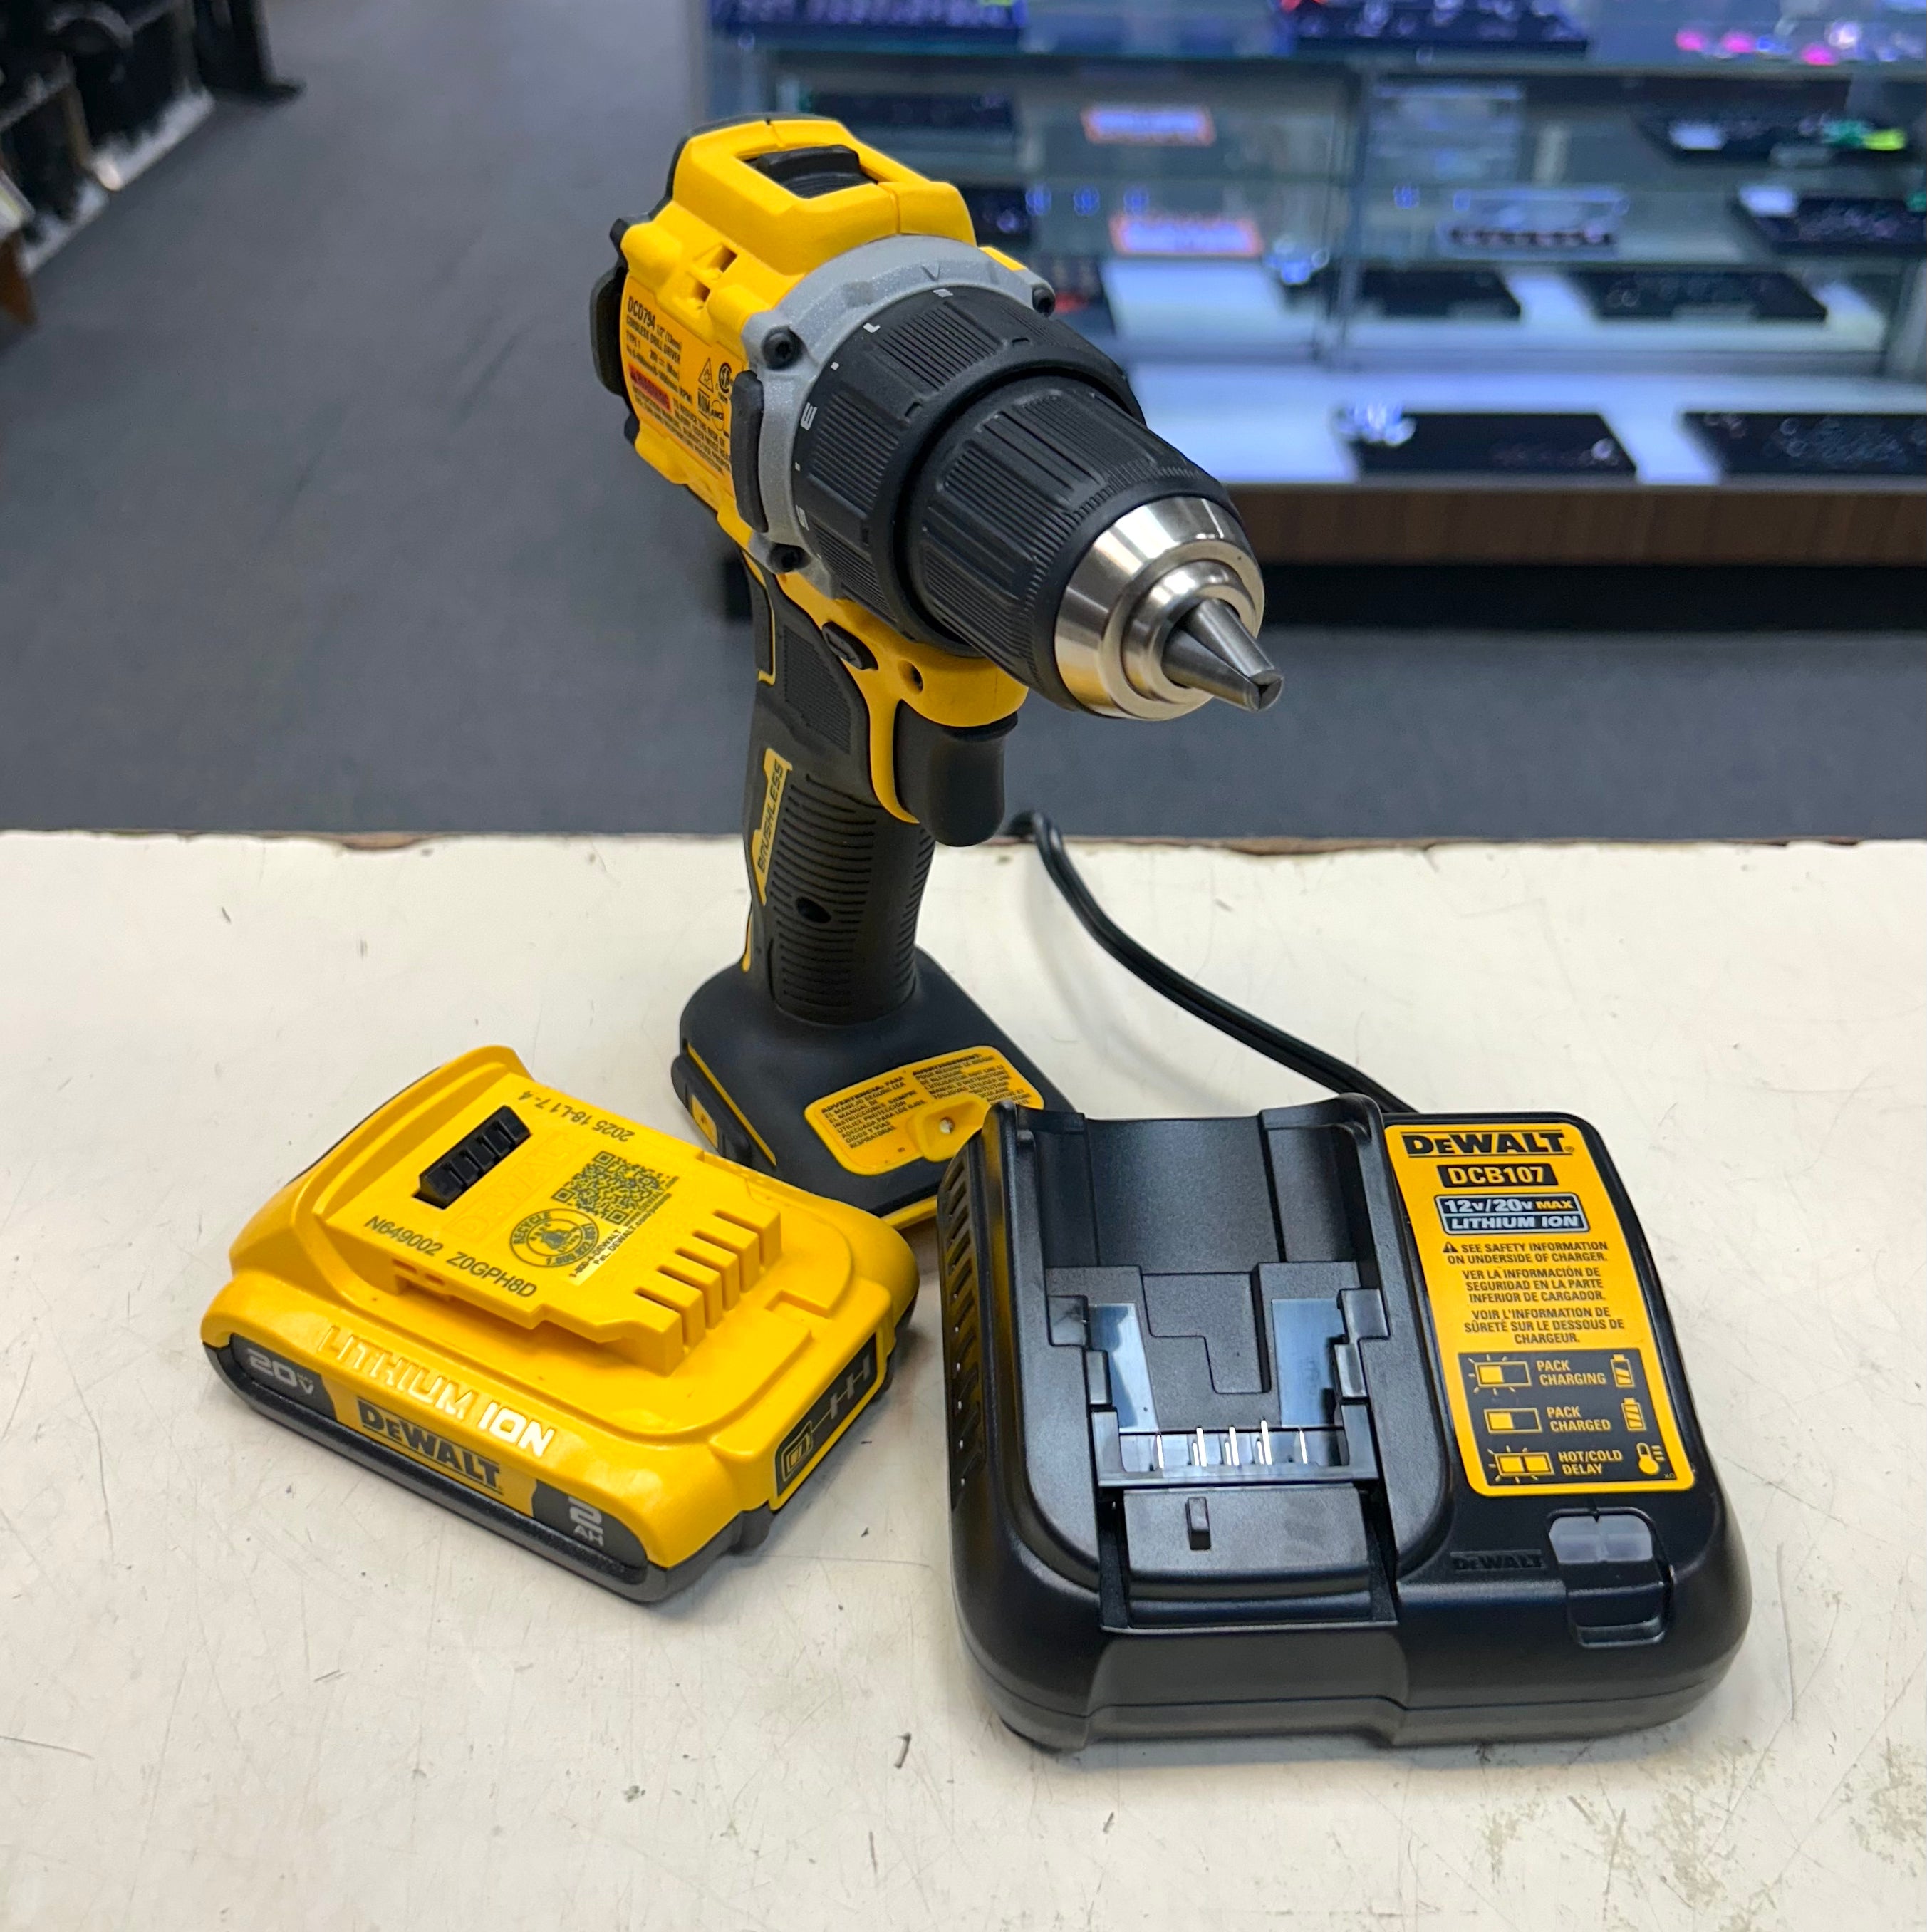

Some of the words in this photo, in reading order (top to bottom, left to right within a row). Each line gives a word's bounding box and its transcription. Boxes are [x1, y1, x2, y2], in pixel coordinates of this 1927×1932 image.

[628, 296, 655, 330] DCD794
[758, 759, 783, 874] BRUSHLESS
[592, 1120, 635, 1141] 2025
[1447, 1166, 1544, 1185] DCB107
[1536, 1200, 1574, 1210] MAX
[513, 1211, 552, 1245] RECYCLE
[1451, 1216, 1535, 1230] LITHIUM
[1542, 1215, 1579, 1227] ION
[365, 1215, 445, 1256] N649002
[1460, 1244, 1480, 1253] SEE
[1485, 1243, 1526, 1252] SAFETY
[1529, 1242, 1608, 1252] INFORMATION
[1448, 1255, 1464, 1264] ON
[1467, 1254, 1532, 1263] UNDERSIDE
[1534, 1254, 1548, 1262] OF
[1552, 1252, 1608, 1262] CHARGER.
[1462, 1270, 1485, 1279] VER
[1487, 1269, 1501, 1279] LA
[1504, 1266, 1581, 1279] INFORMACIÓN
[1585, 1267, 1600, 1277] DE
[1465, 1281, 1531, 1291] SEGURIDAD
[1534, 1280, 1548, 1289] EN
[1552, 1280, 1566, 1289] LA
[1568, 1279, 1604, 1289] PARTE
[1469, 1292, 1521, 1303] INFERIOR
[1523, 1292, 1539, 1302] DE
[1541, 1291, 1606, 1302] CARGADOR.
[1471, 1309, 1499, 1320] VOIR
[1502, 1308, 1593, 1319] L'INFORMATION
[1596, 1307, 1611, 1316] DE
[1464, 1319, 1508, 1332] SÛRETÉ
[1510, 1322, 1534, 1331] SUR
[1537, 1321, 1549, 1330] LE
[1552, 1320, 1606, 1330] DESSOUS
[1609, 1319, 1624, 1329] DE
[1514, 1333, 1580, 1344] CHARGEUR.
[1537, 1360, 1571, 1371] PACK
[1539, 1372, 1607, 1386] CHARGING
[317, 1325, 478, 1421] LITHIUM
[479, 1401, 554, 1458] ION
[1546, 1406, 1581, 1418] PACK
[1549, 1419, 1611, 1432] CHARGED
[1558, 1449, 1623, 1463] HOT/COLD
[1562, 1464, 1603, 1475] DELAY
[568, 1496, 604, 1535] 2
